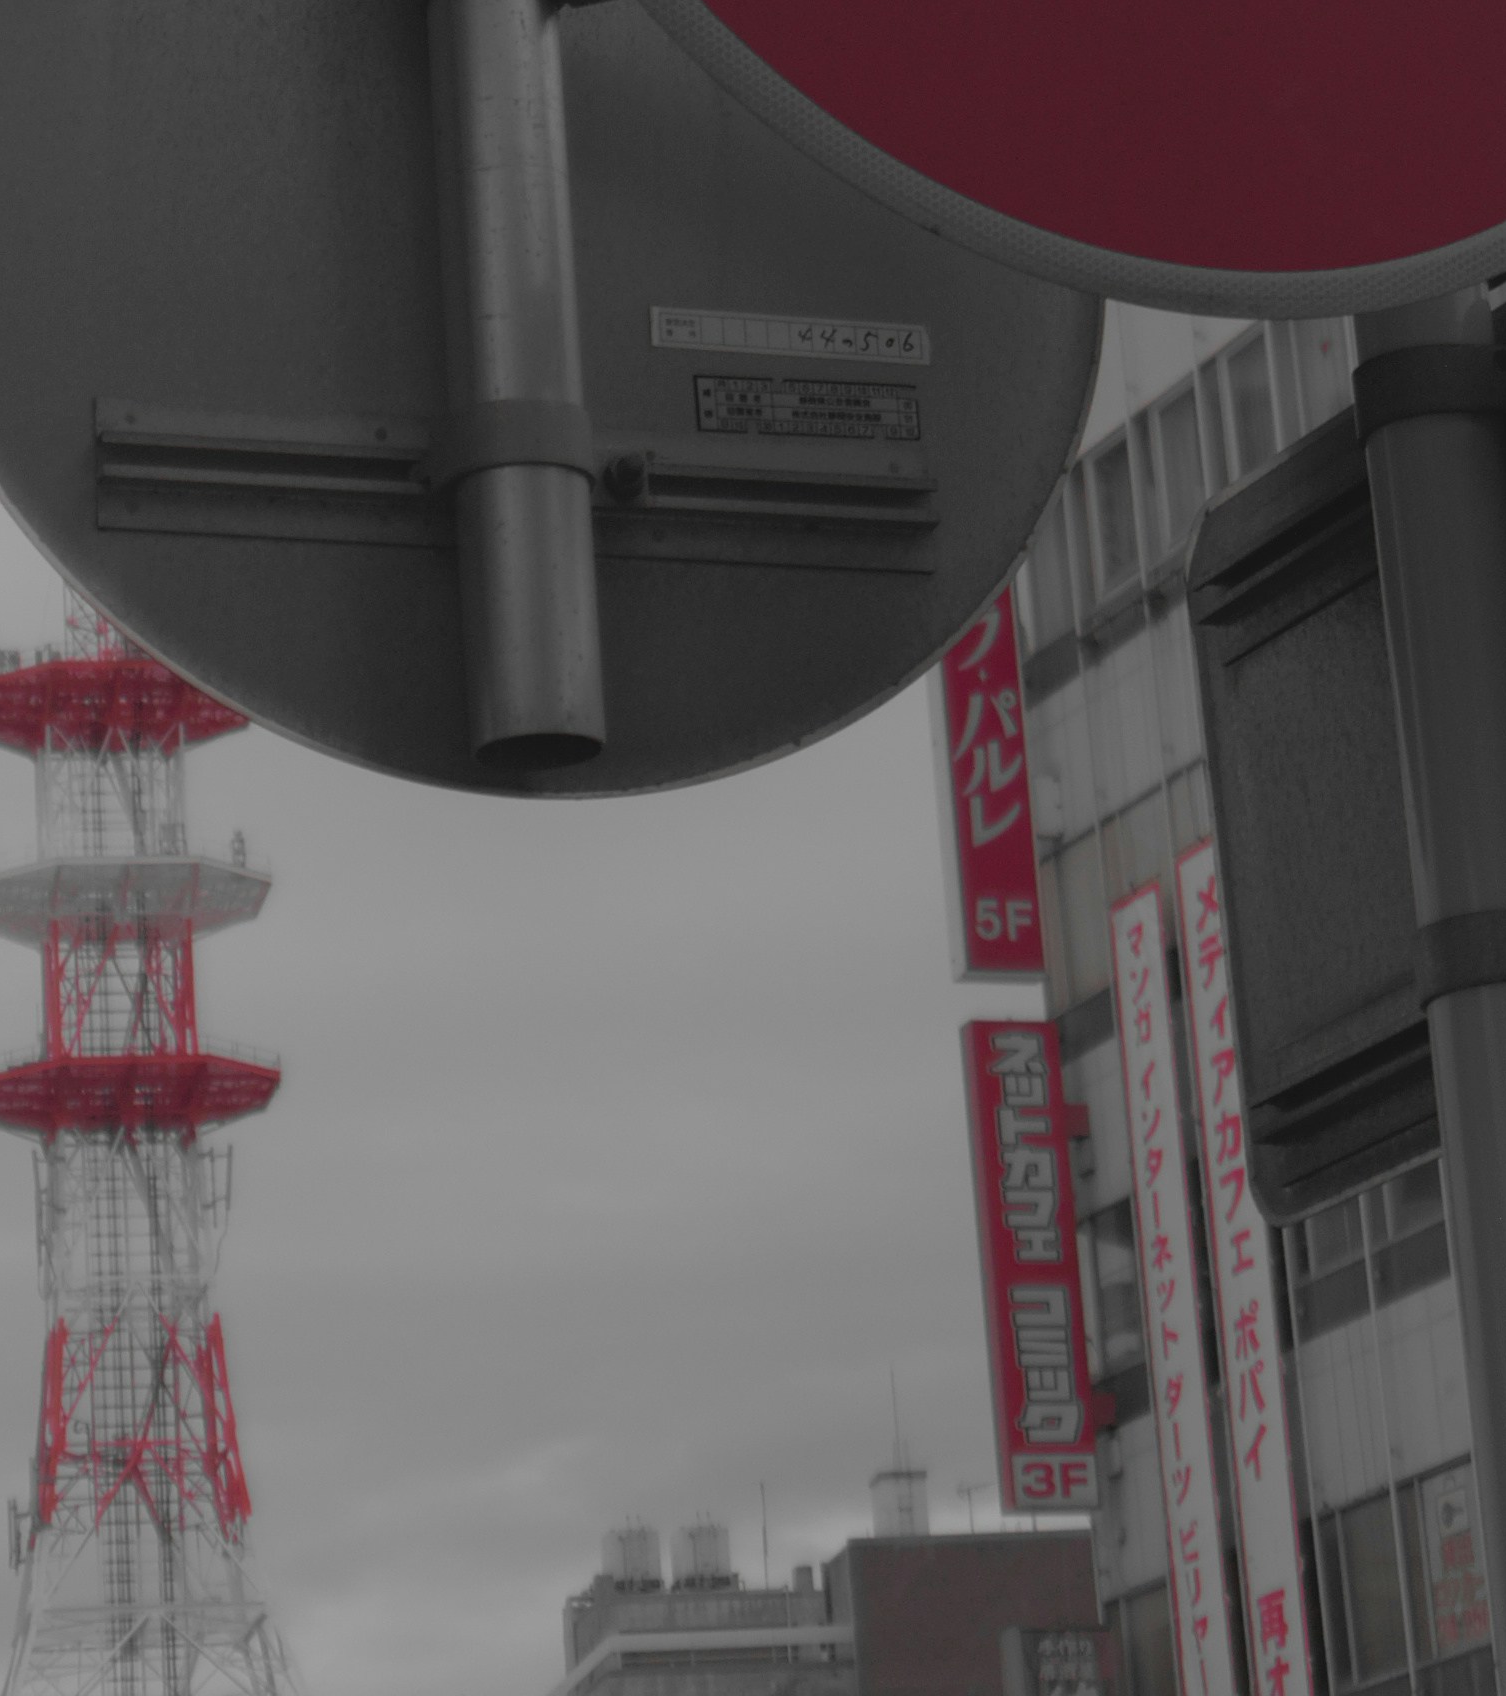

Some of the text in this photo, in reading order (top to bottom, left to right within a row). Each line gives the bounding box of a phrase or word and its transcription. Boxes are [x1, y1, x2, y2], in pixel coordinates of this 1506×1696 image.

[974, 899, 1033, 943] 5F
[990, 1031, 1085, 1445] ネットカフェ コミック
[1019, 1461, 1089, 1500] 3F
